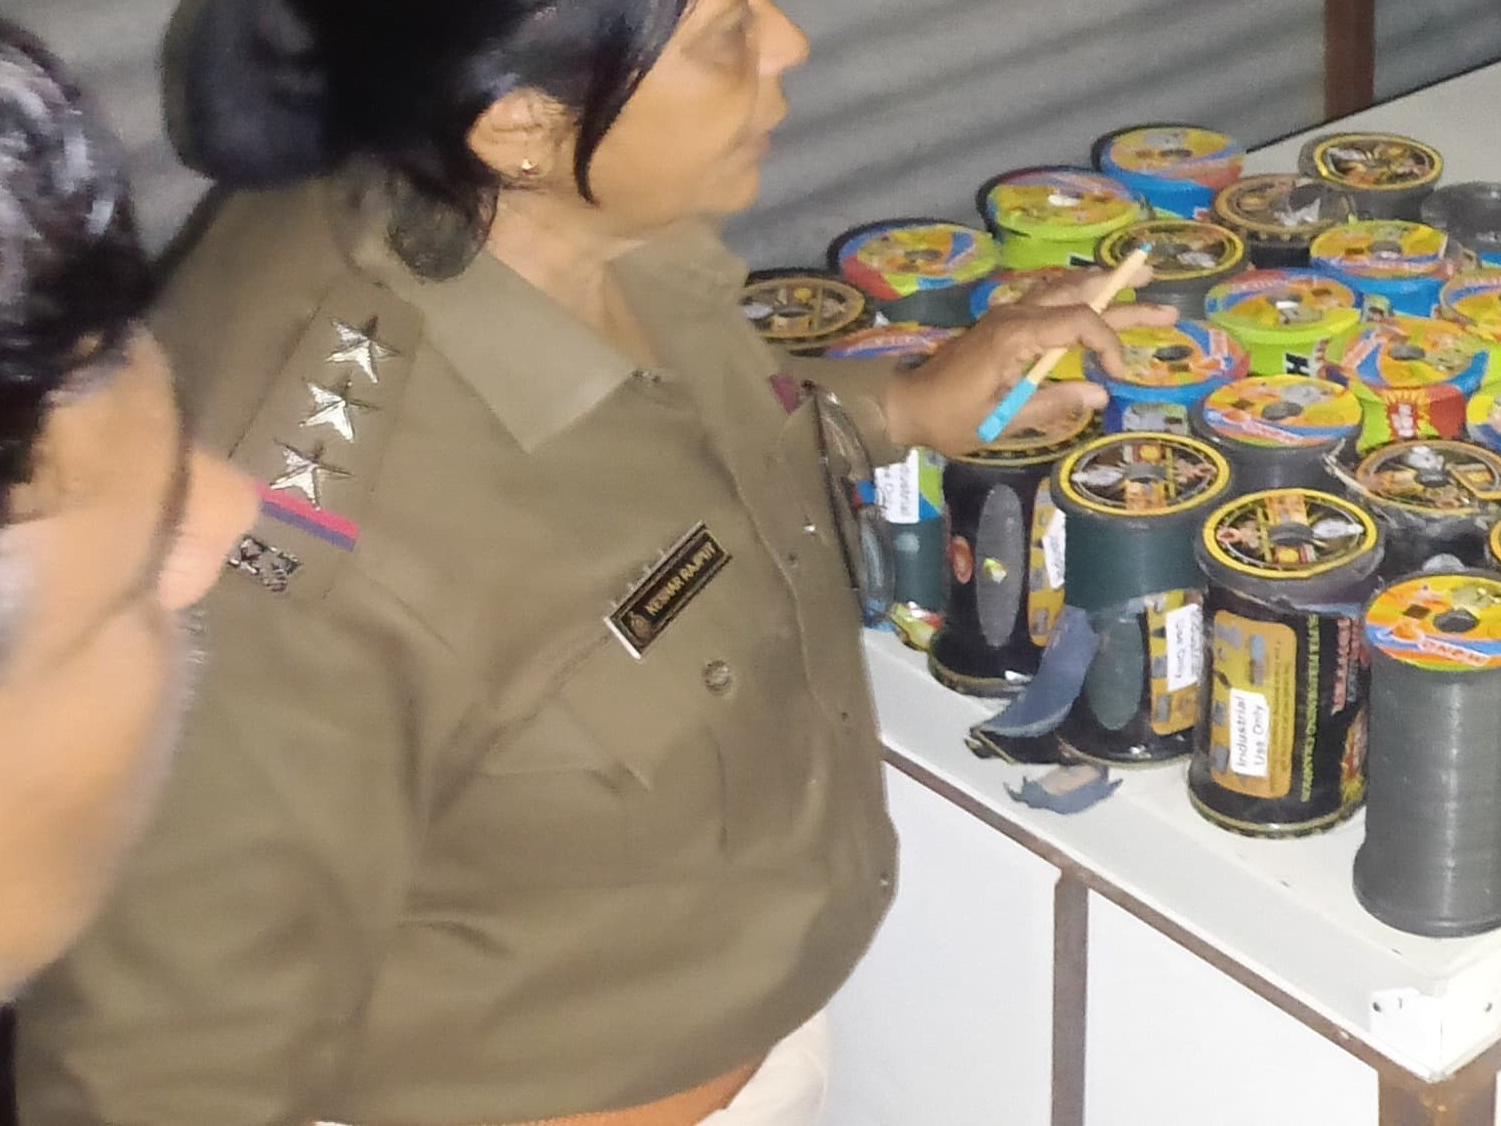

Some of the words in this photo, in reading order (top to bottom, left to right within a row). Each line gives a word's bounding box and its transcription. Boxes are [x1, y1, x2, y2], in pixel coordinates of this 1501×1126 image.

[1234, 696, 1248, 767] Industrial
[1253, 703, 1267, 735] Only
[1254, 740, 1267, 766] Use
